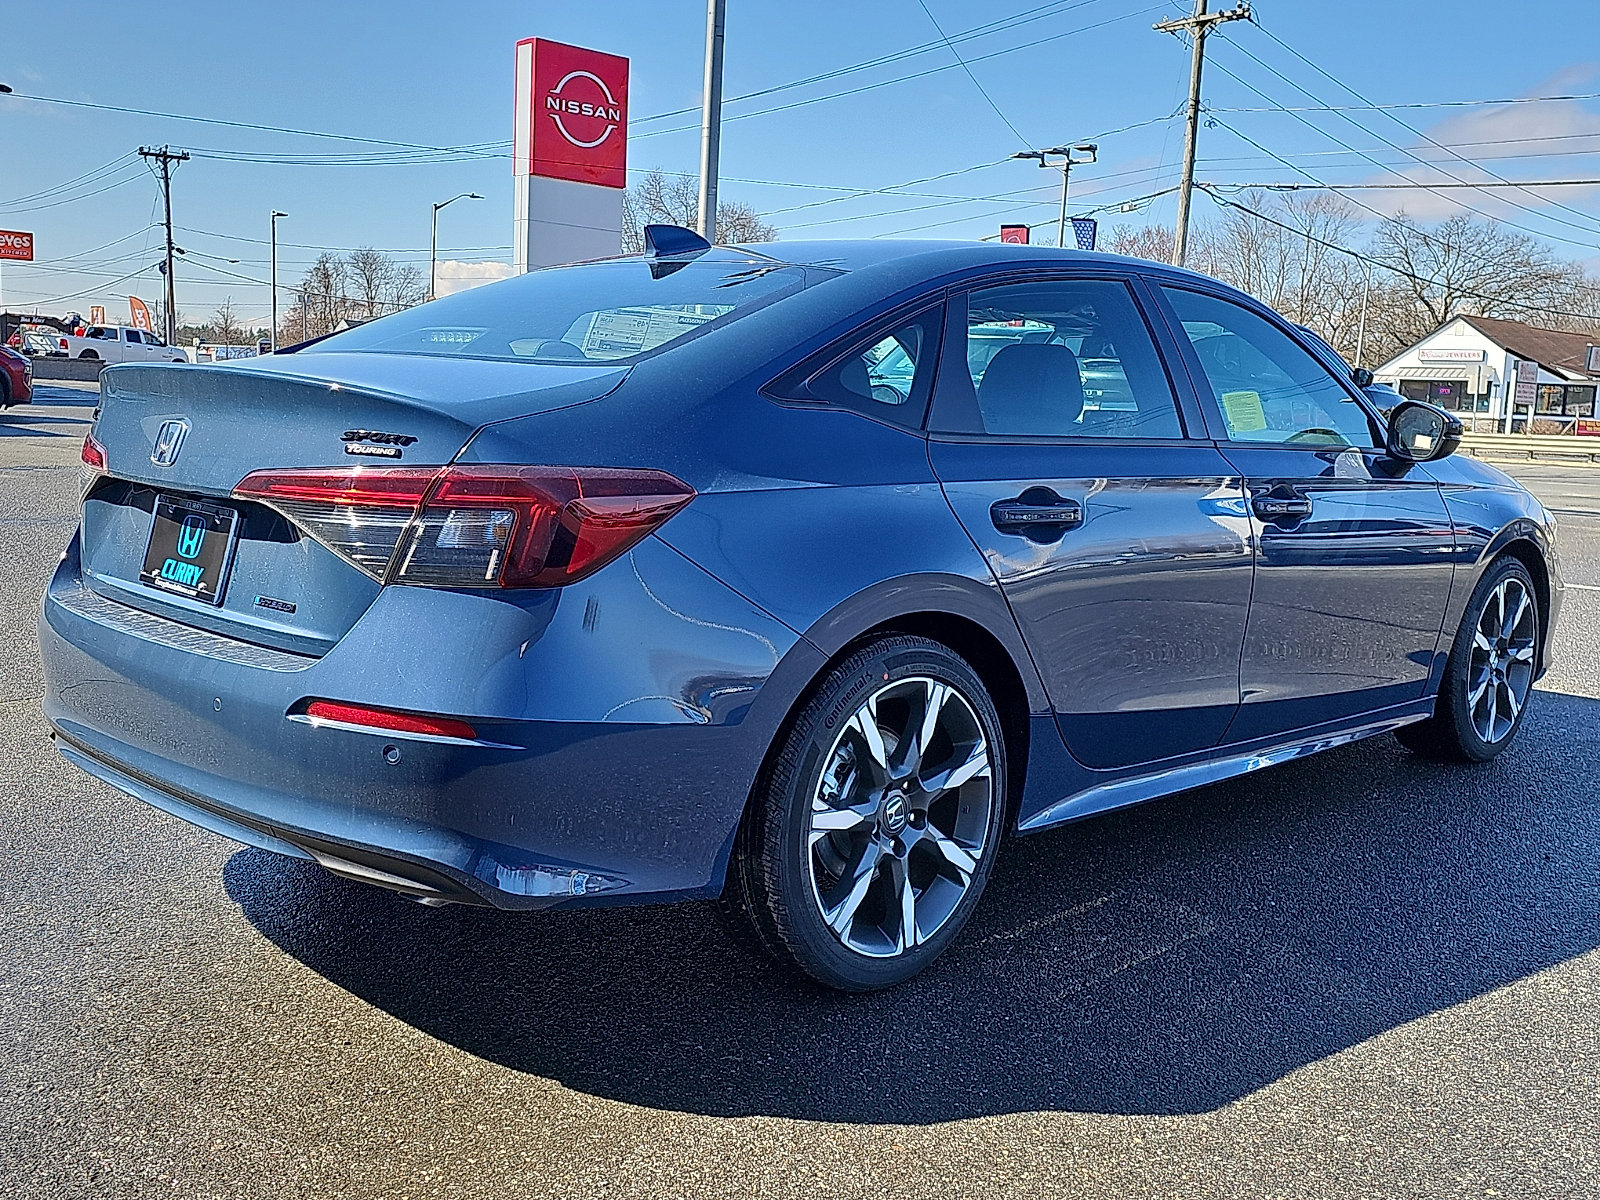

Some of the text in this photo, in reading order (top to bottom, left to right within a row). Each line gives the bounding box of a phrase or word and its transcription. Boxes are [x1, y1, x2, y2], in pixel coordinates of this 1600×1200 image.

[546, 96, 620, 121] NISSAN
[340, 430, 419, 447] SPORT
[346, 444, 396, 455] TOURING
[161, 558, 204, 587] CURRY
[824, 675, 869, 730] Continental
